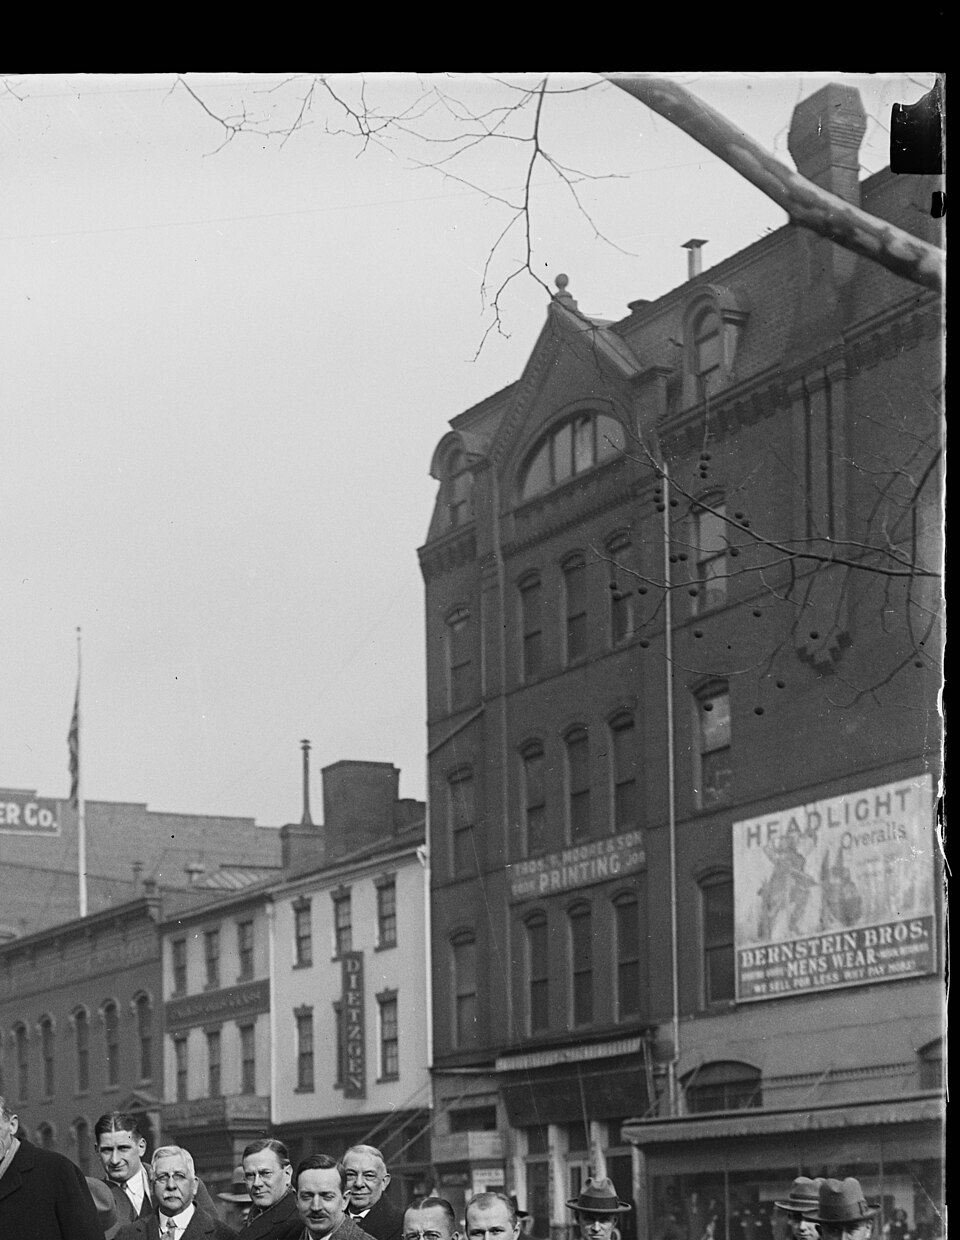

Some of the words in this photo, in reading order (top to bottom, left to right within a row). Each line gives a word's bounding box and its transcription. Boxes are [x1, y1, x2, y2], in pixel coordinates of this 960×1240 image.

[25, 802, 59, 829] Co.
[747, 787, 911, 848] HEADLIGHT
[840, 822, 907, 850] Overalls
[539, 853, 621, 893] PRINTING
[741, 932, 858, 968] BERNSTEIN
[864, 920, 929, 947] BROS.
[768, 980, 791, 992] SELL
[814, 971, 840, 985] LESS
[867, 963, 885, 976] PAY
[787, 956, 828, 978] MENS
[831, 948, 877, 969] WEAR
[346, 958, 362, 1089] DIETZGEN
